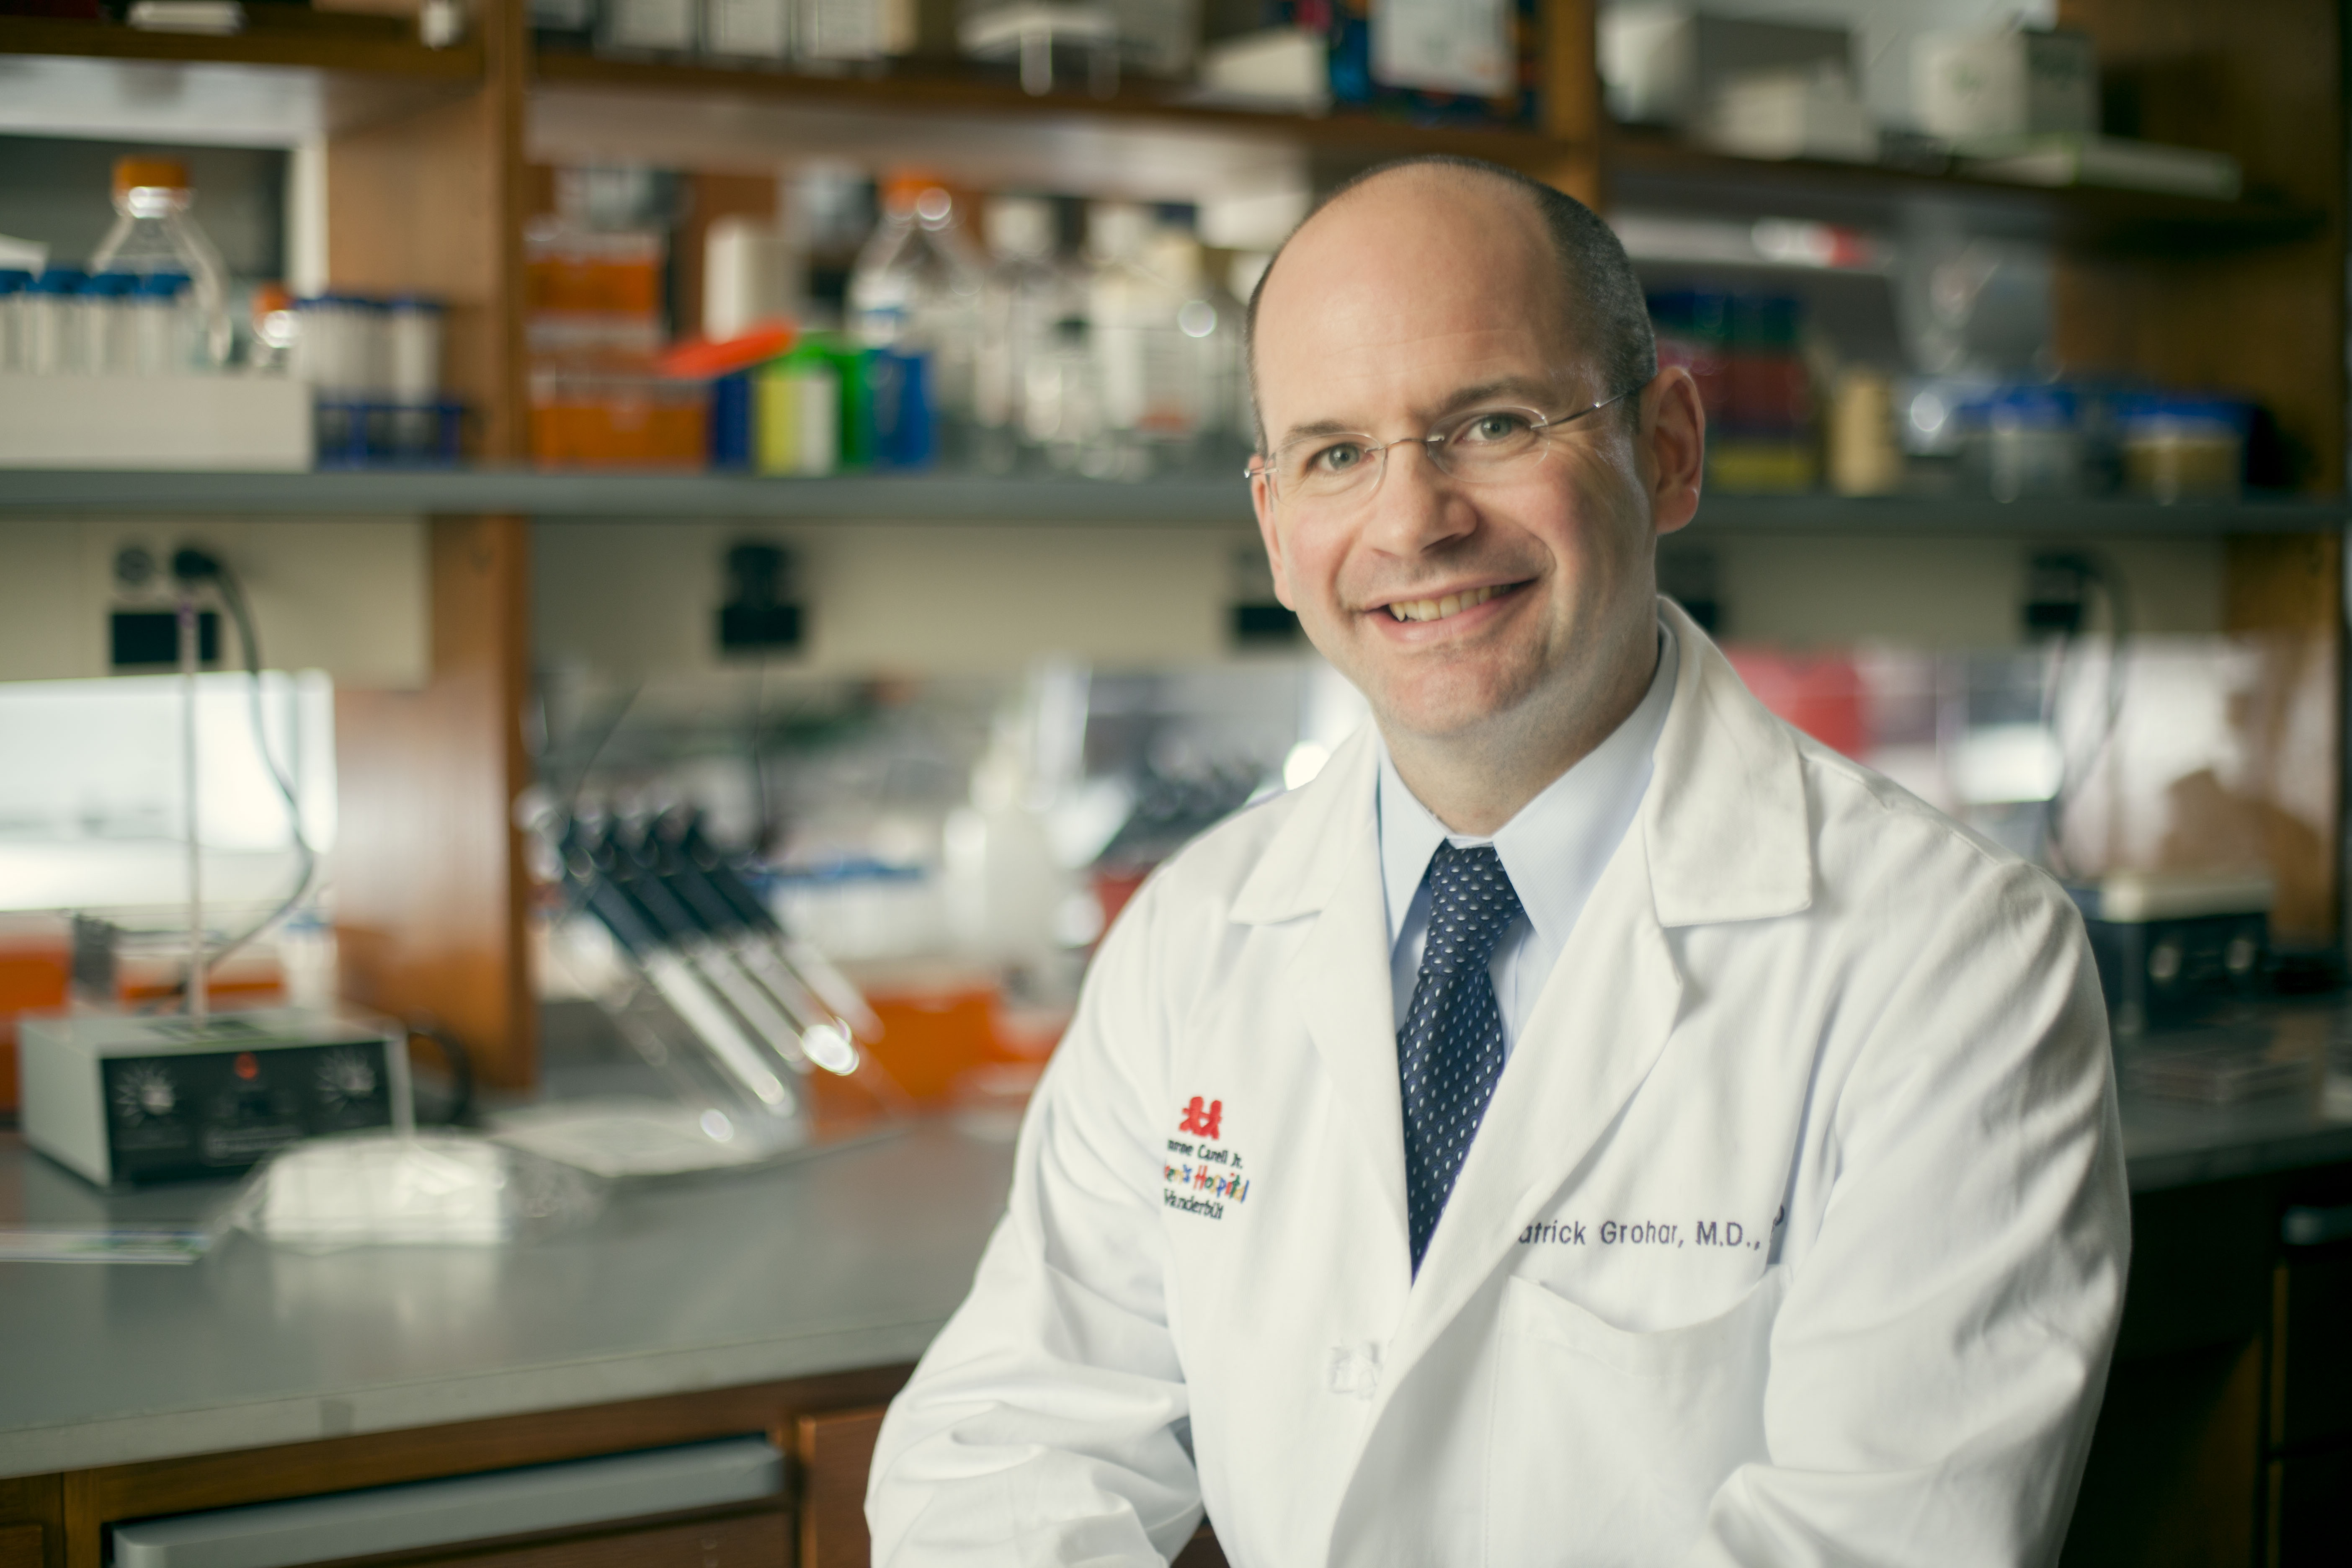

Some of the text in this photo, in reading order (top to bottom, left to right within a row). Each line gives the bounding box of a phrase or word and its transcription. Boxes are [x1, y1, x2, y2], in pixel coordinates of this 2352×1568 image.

[1198, 1144, 1228, 1164] Carell
[1600, 1220, 1684, 1248] Grohar,
[1695, 1220, 1760, 1251] M.D.,
